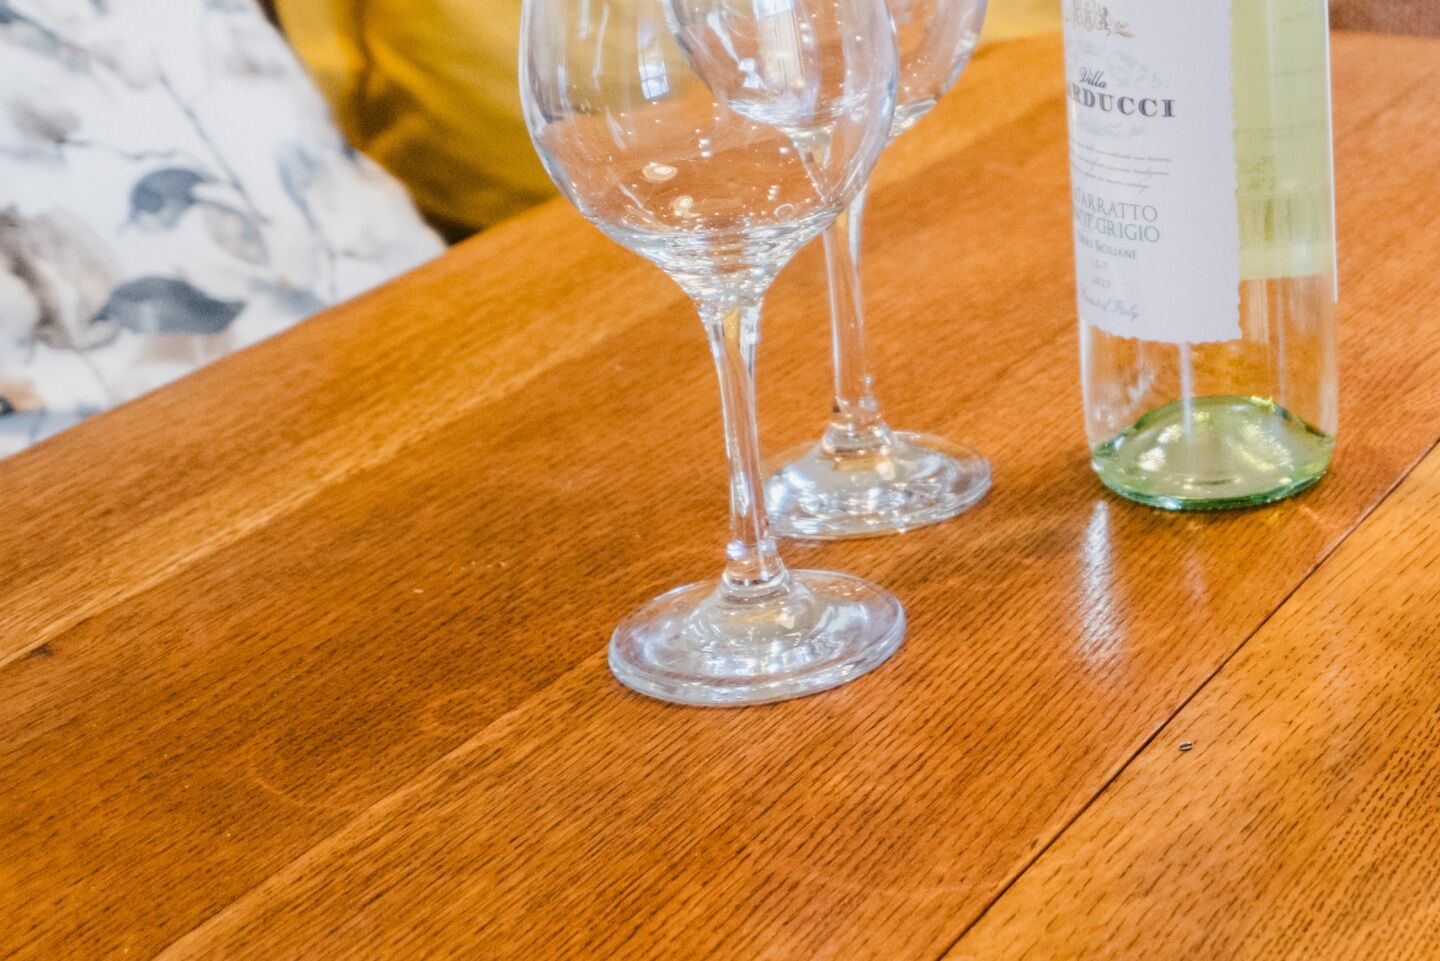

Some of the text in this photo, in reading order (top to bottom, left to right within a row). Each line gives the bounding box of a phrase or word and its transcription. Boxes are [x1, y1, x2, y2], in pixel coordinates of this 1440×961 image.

[1079, 66, 1108, 90] Villa
[1068, 82, 1177, 118] RDUCCI
[1096, 217, 1161, 244] GRIGIO
